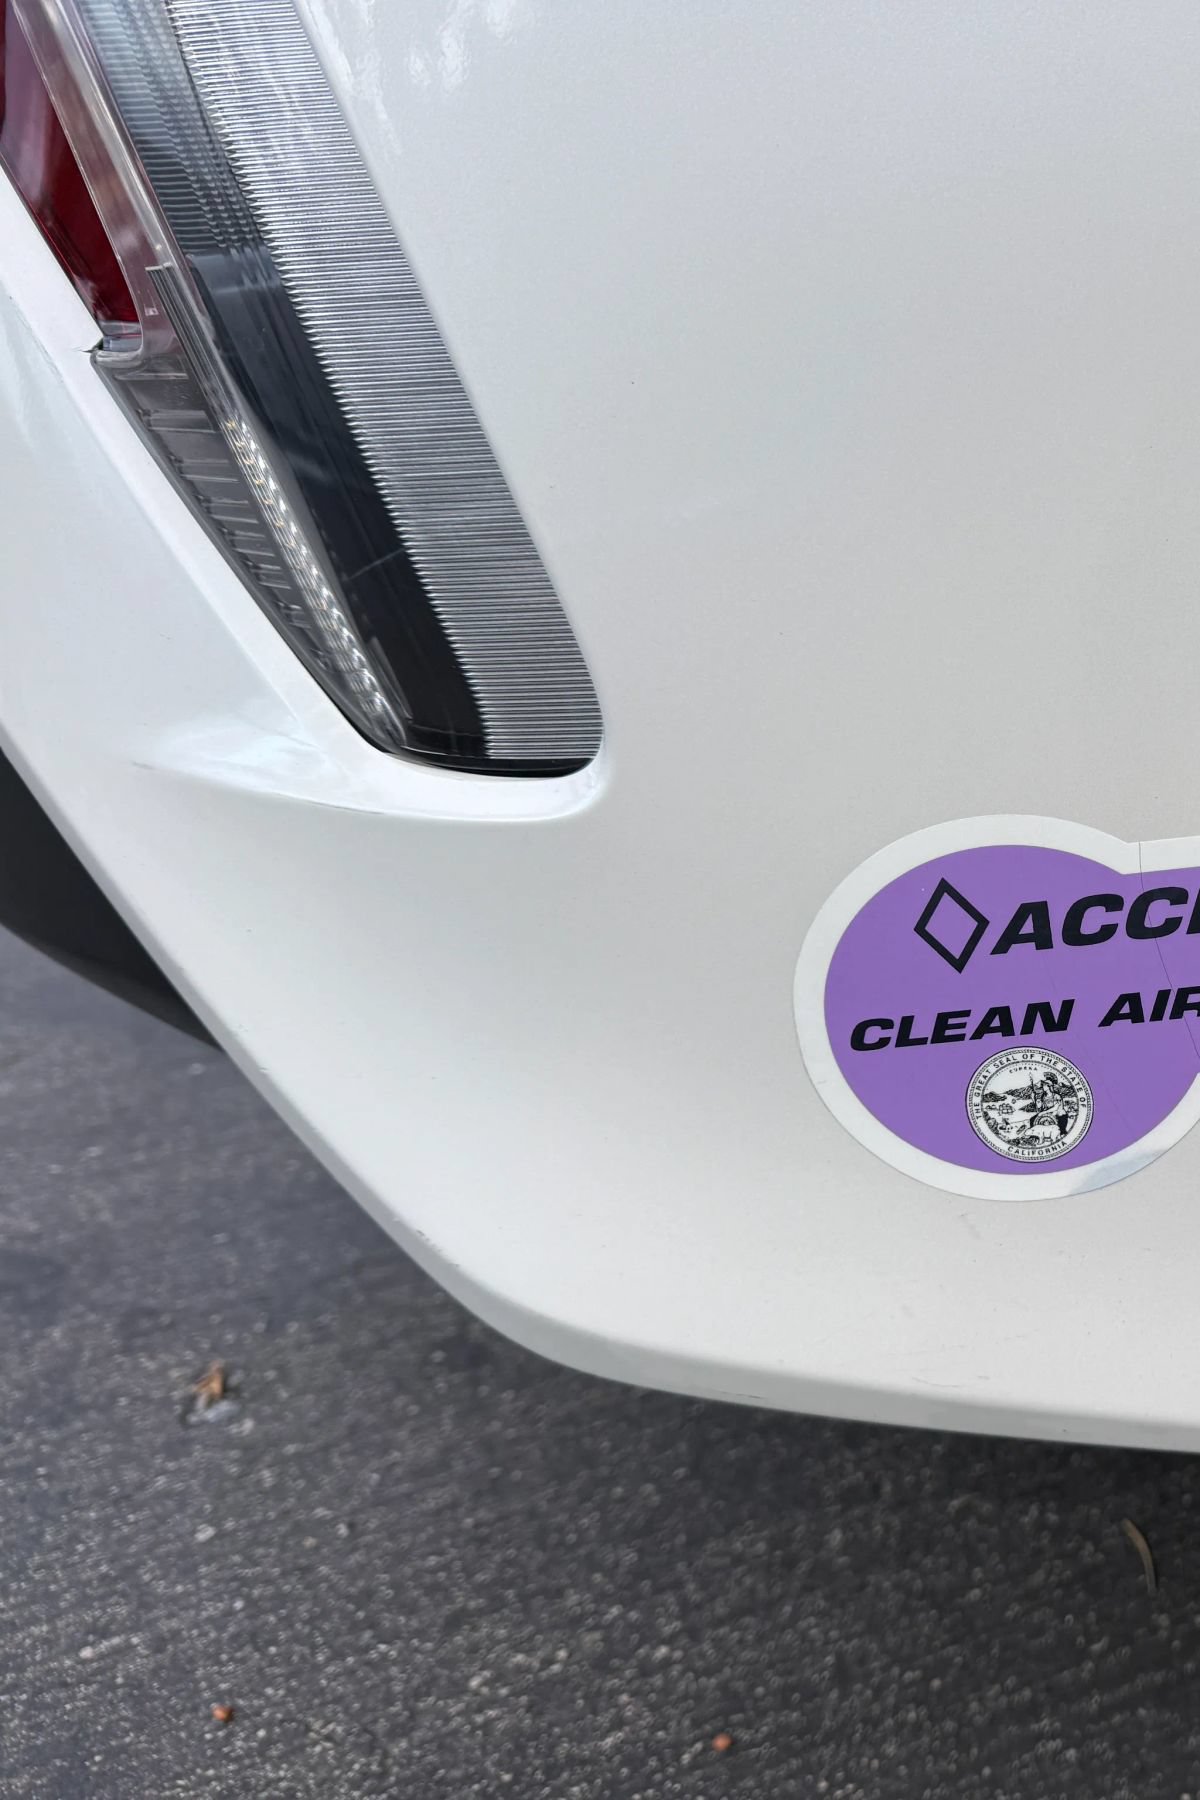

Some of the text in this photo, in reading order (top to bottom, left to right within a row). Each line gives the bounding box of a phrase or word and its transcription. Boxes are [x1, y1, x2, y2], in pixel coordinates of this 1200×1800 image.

[851, 999, 1075, 1051] CLEAN
[993, 1054, 1017, 1069] SEAL
[1040, 1055, 1058, 1066] THE
[975, 1069, 991, 1098] GREAT
[1060, 1066, 1084, 1092] STATE
[1079, 1097, 1087, 1108] OF
[973, 1103, 982, 1120] THE
[1007, 1141, 1067, 1156] CALIFORNIA
